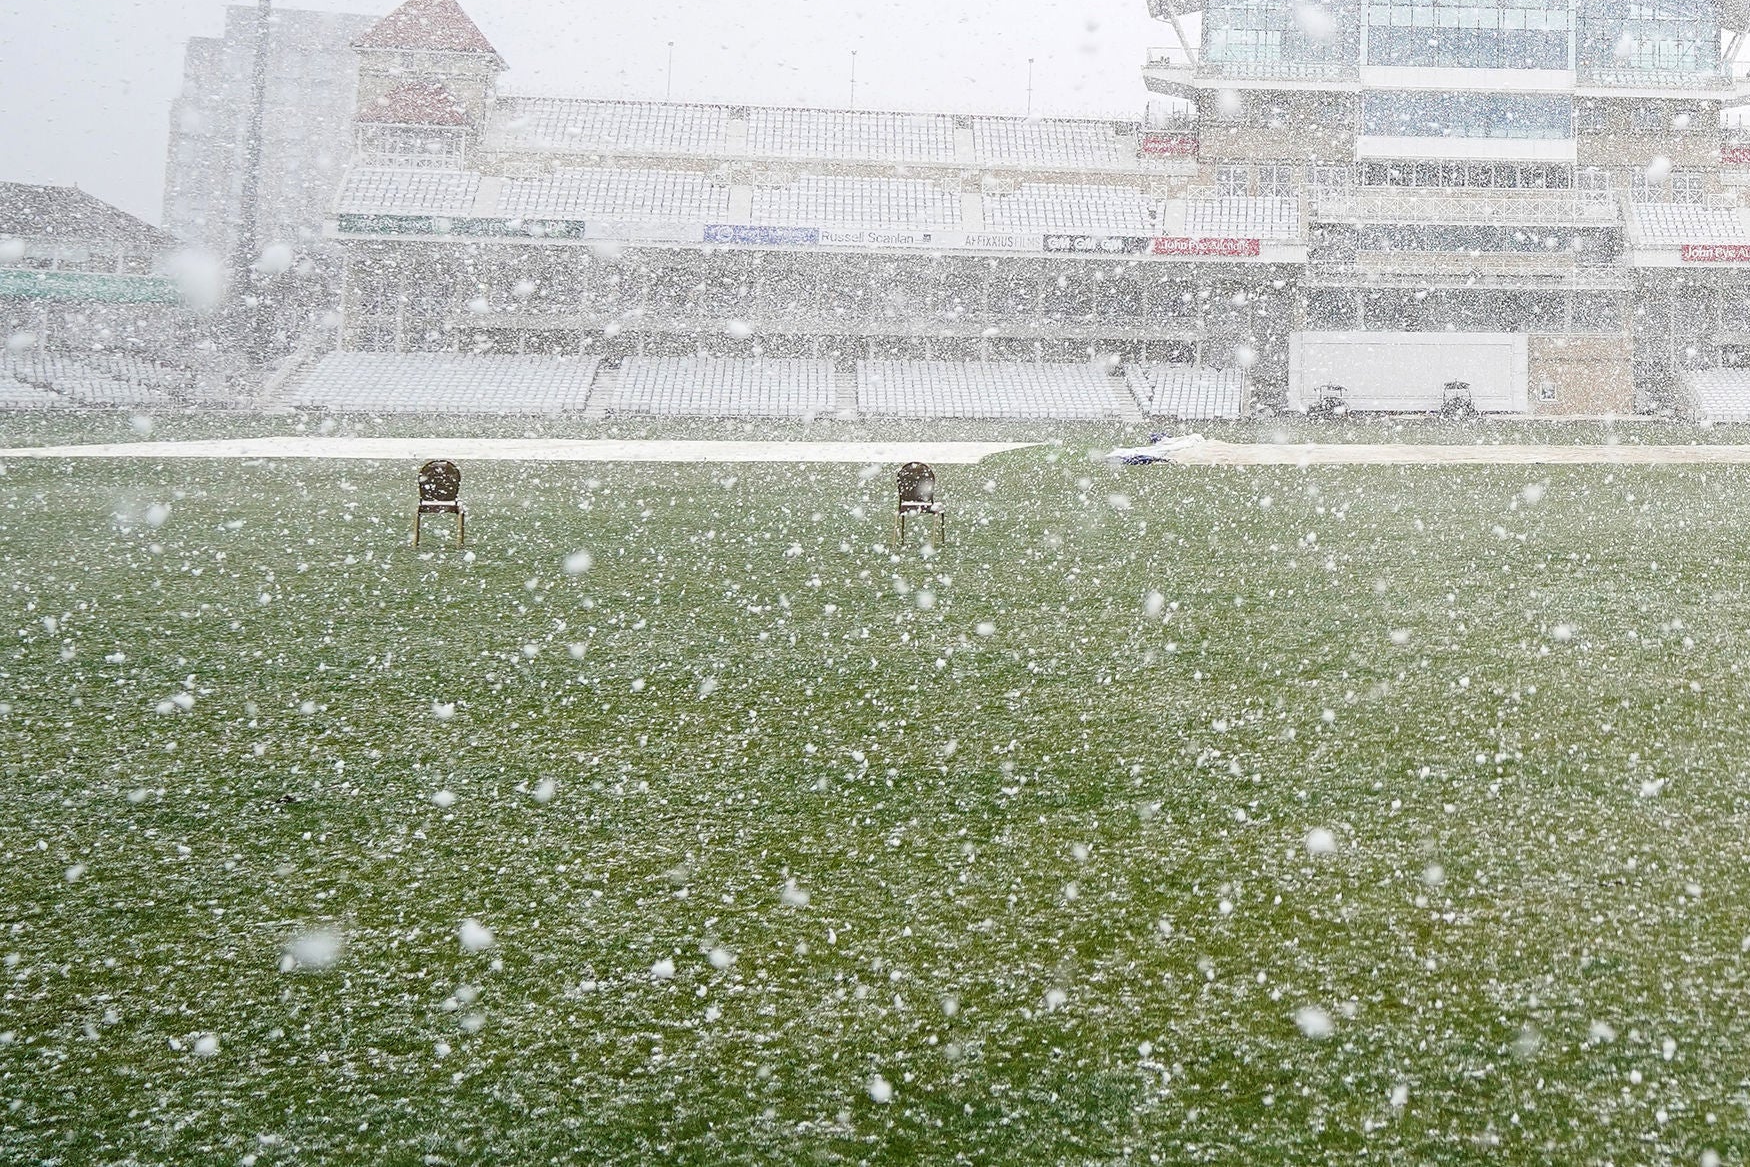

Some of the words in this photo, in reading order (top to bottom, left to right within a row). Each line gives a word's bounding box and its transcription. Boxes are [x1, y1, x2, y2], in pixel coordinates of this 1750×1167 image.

[821, 233, 864, 243] Russell
[868, 234, 914, 245] Scanlan
[1160, 241, 1187, 250] John
[1189, 241, 1208, 252] Pye
[1685, 246, 1713, 259] John
[1715, 246, 1736, 261] Pye
